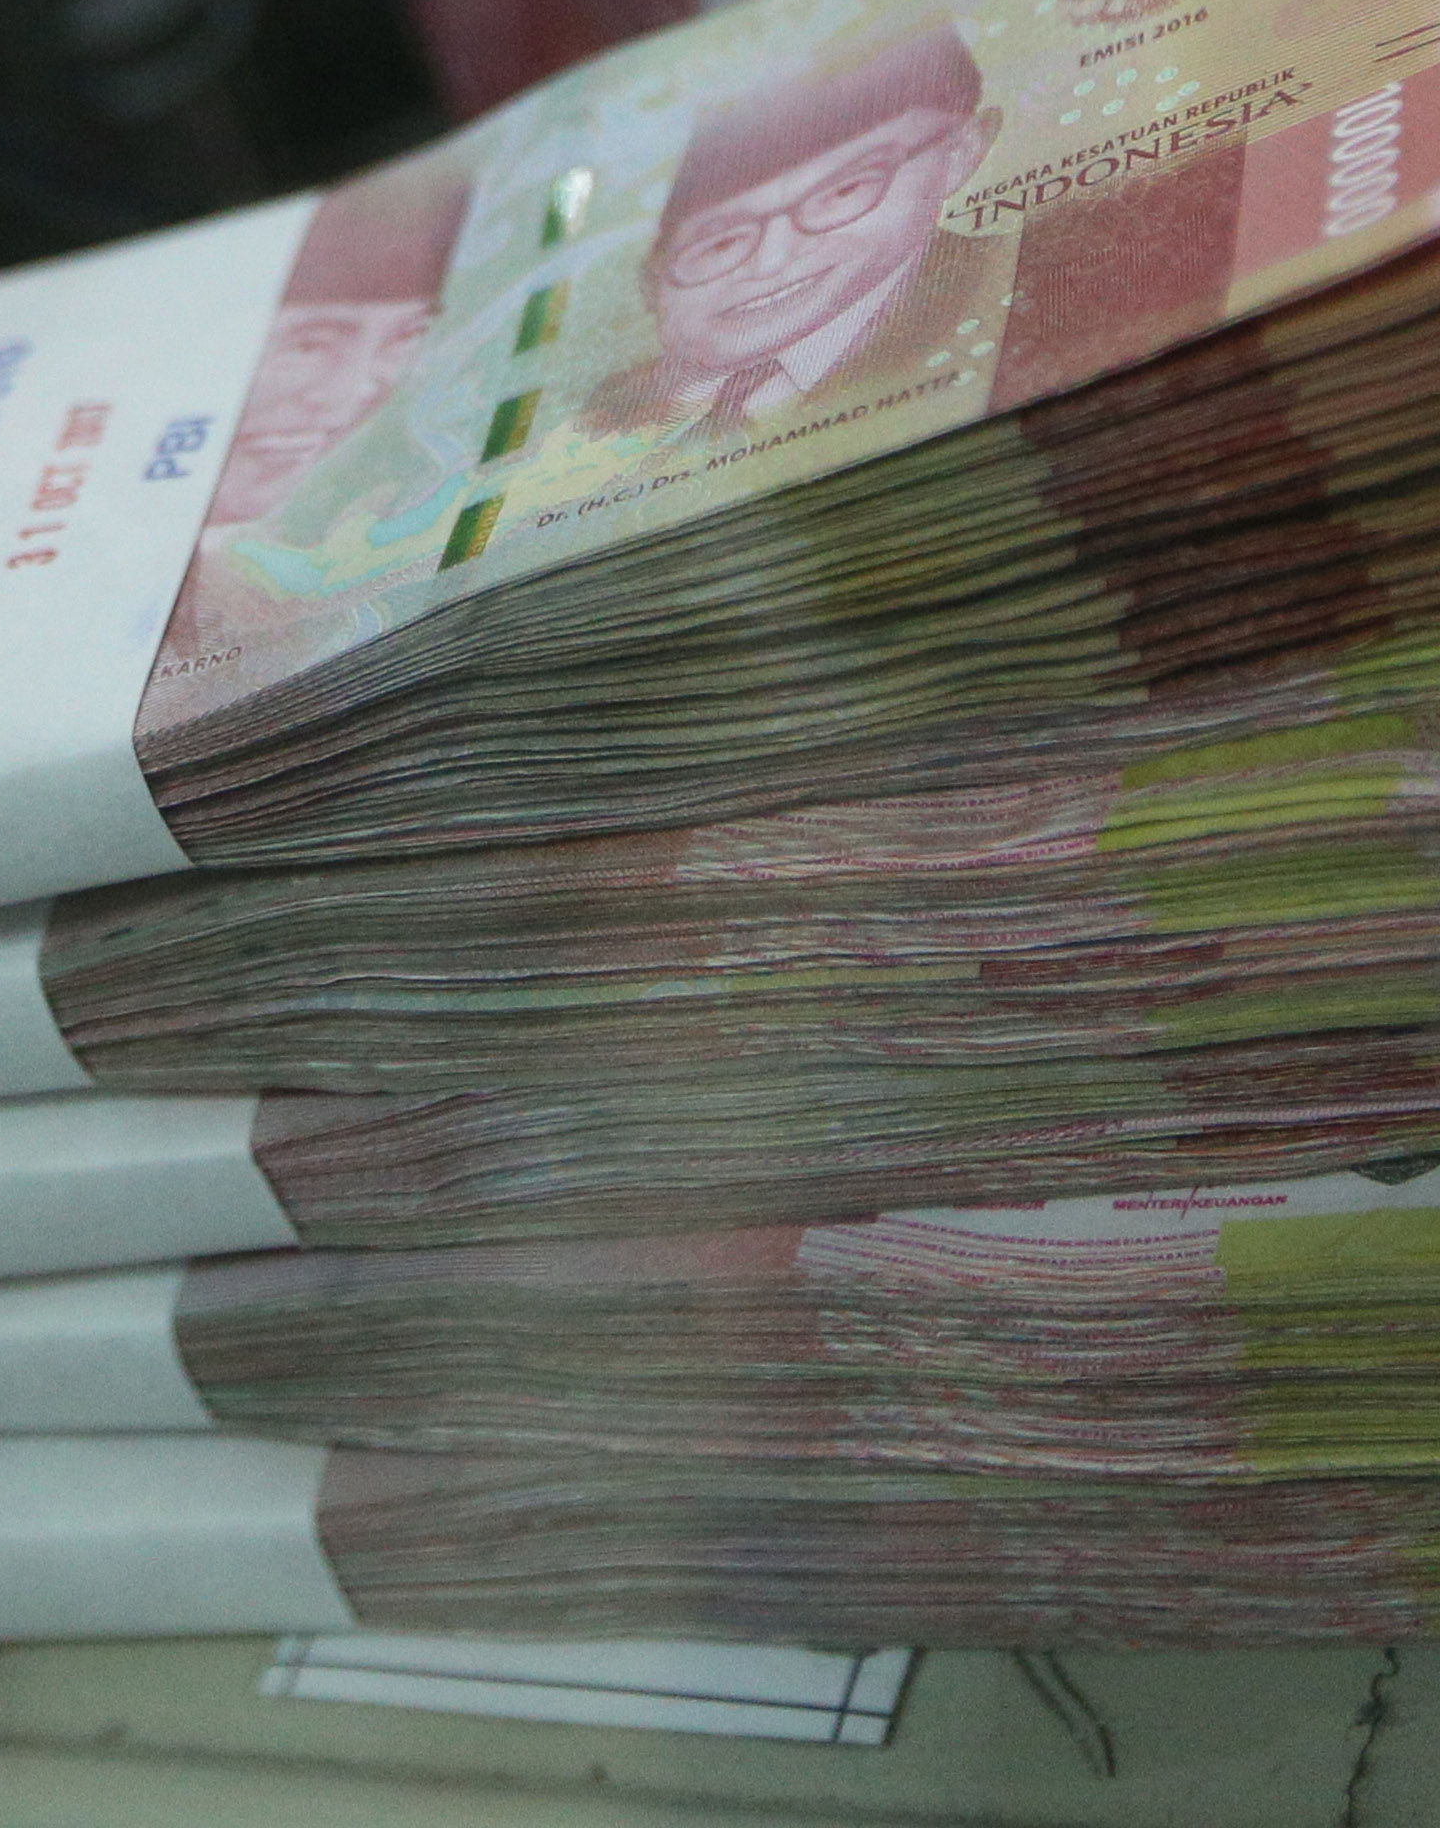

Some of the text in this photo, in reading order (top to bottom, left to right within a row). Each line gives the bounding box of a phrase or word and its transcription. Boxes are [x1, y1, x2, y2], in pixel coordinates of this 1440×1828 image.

[1079, 6, 1209, 68] EMISI 2016
[946, 80, 1314, 231] INDONESIA
[965, 67, 1296, 208] NEGARA KESATUAN REPUBLIK
[536, 510, 570, 529] Dr.
[651, 470, 696, 492] Drs.
[705, 403, 870, 472] MOHAMMAD
[876, 369, 961, 412] HATTA
[1191, 1194, 1289, 1210] KEUANGAN
